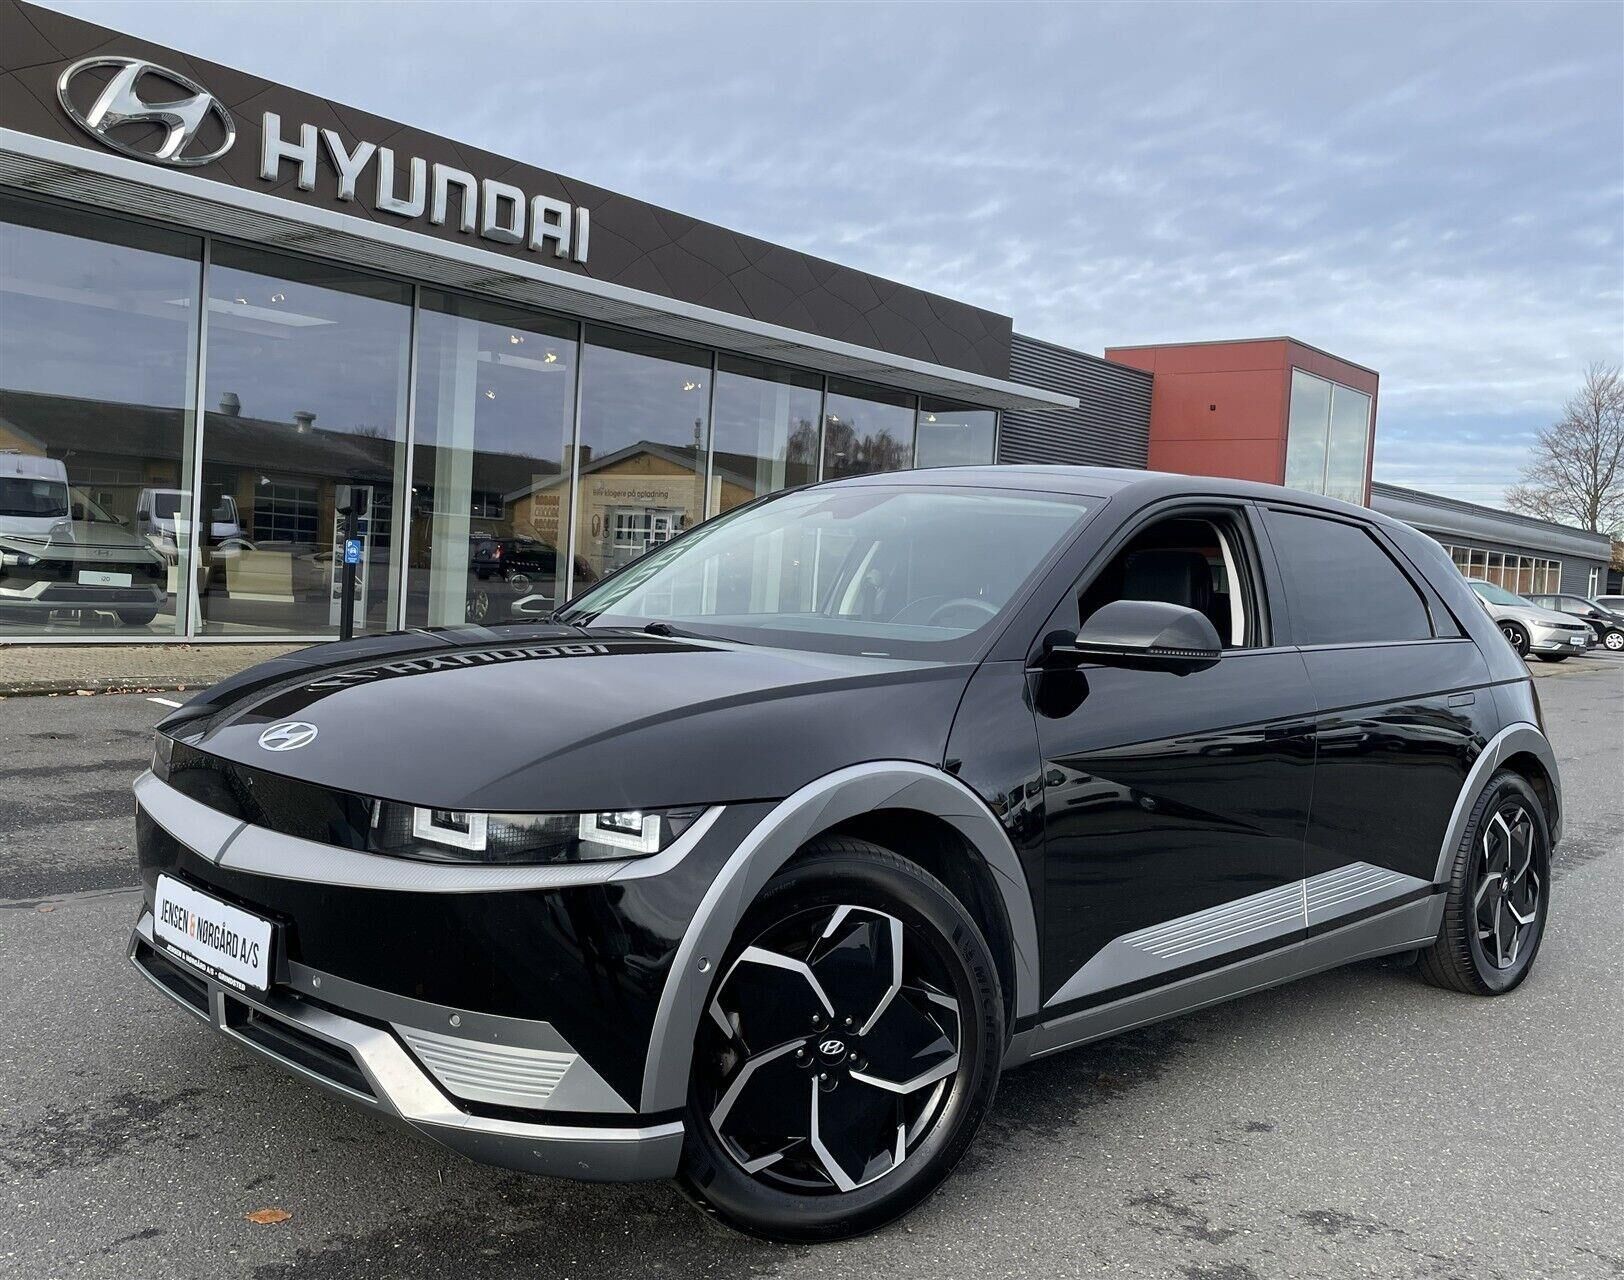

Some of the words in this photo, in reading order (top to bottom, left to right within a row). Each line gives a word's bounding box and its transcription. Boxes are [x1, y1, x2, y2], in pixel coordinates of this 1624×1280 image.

[260, 111, 590, 263] HYUNDAI
[627, 488, 636, 497] på
[161, 899, 189, 934] JENSEN
[190, 913, 196, 938] &
[197, 916, 239, 959] NØRGÅRD
[240, 937, 260, 969] A/S
